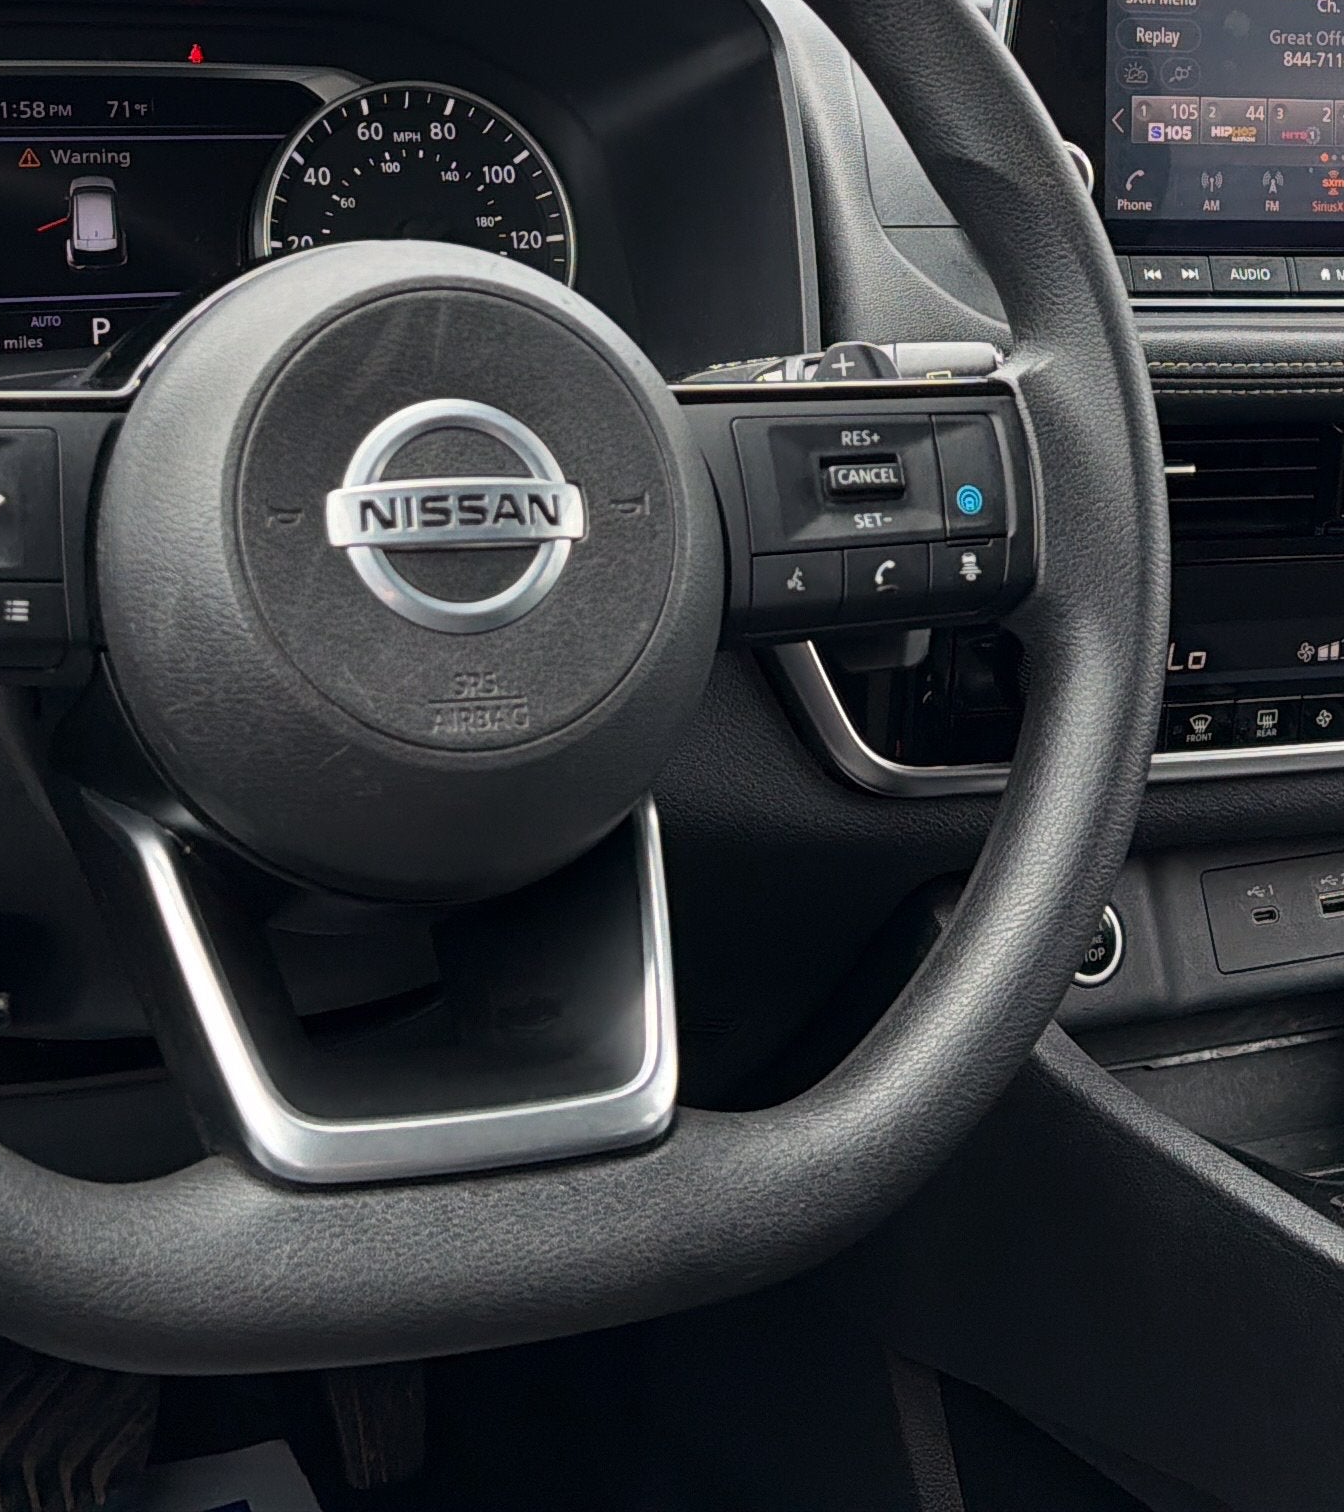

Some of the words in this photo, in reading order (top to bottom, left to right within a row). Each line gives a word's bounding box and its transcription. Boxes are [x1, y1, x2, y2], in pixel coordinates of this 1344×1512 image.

[1136, 26, 1181, 48] Replay
[1269, 29, 1312, 47] Great
[0, 100, 46, 119] 1:58
[49, 104, 73, 117] PM
[1139, 105, 1147, 117] 1
[1170, 104, 1199, 120] 105
[1208, 106, 1217, 118] 2
[1245, 105, 1265, 121] 44
[1276, 107, 1284, 120] 3
[1321, 107, 1332, 123] 2
[356, 122, 383, 141] 60
[393, 131, 421, 143] MPH
[429, 122, 456, 140] 80
[1165, 125, 1193, 140] 105
[49, 148, 132, 168] Warning
[380, 161, 401, 174] 100
[481, 165, 516, 185] 100
[303, 166, 331, 186] 40
[440, 170, 460, 183] 140
[340, 196, 356, 209] 60
[1117, 198, 1153, 212] Phone
[1202, 200, 1221, 212] AM
[1265, 200, 1280, 212] FM
[475, 216, 495, 228] 180
[510, 230, 543, 250] 120
[1230, 268, 1271, 281] AUDIO
[30, 314, 62, 328] AUTO
[91, 317, 112, 346] P
[3, 335, 44, 350] miles
[837, 467, 899, 486] CANCEL
[358, 492, 562, 534] NISSAN
[1185, 732, 1214, 744] FRONT
[1256, 727, 1278, 738] REAR
